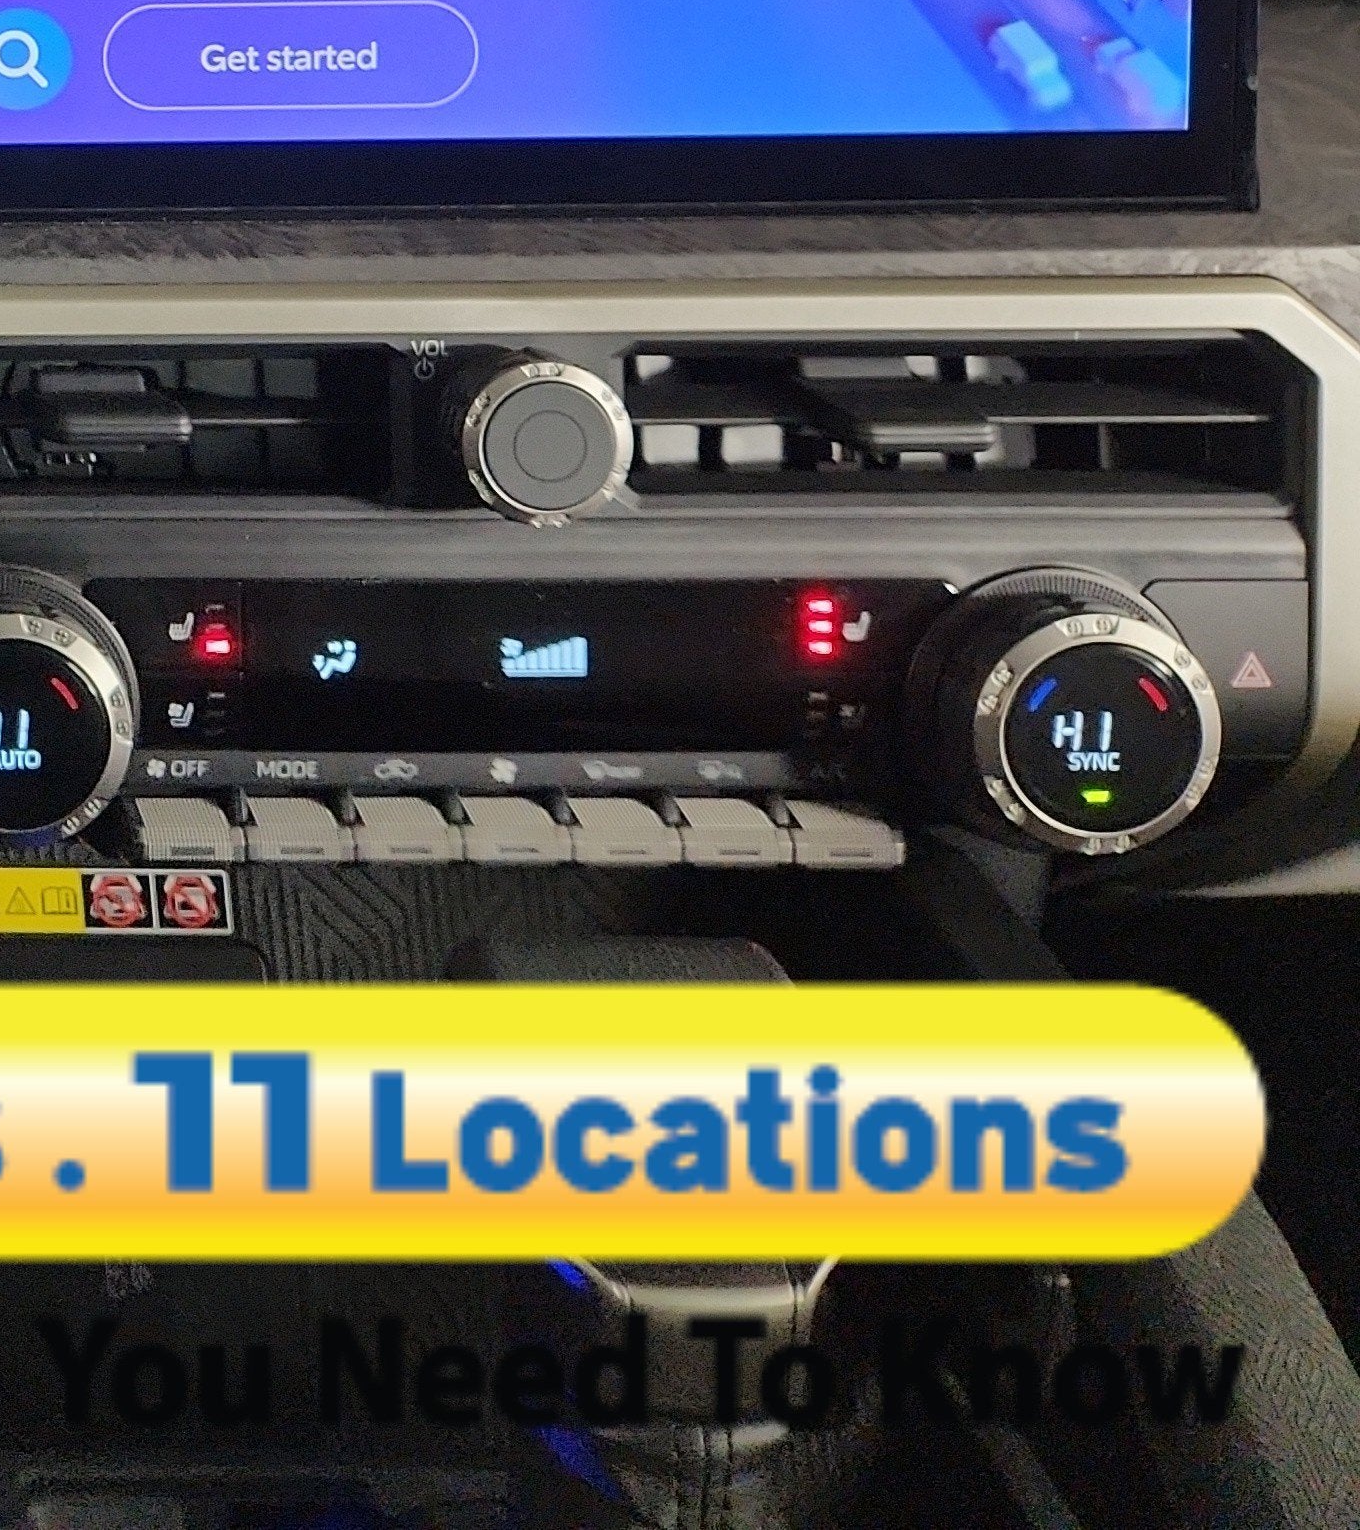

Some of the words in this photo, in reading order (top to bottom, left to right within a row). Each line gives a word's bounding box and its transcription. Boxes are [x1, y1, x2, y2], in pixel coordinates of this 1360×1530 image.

[200, 43, 261, 73] Get
[265, 40, 379, 72] started
[410, 339, 450, 357] VOL
[1050, 710, 1115, 753] HI
[170, 759, 210, 778] OFF
[256, 759, 320, 779] MODE
[1066, 751, 1122, 774] SYNC
